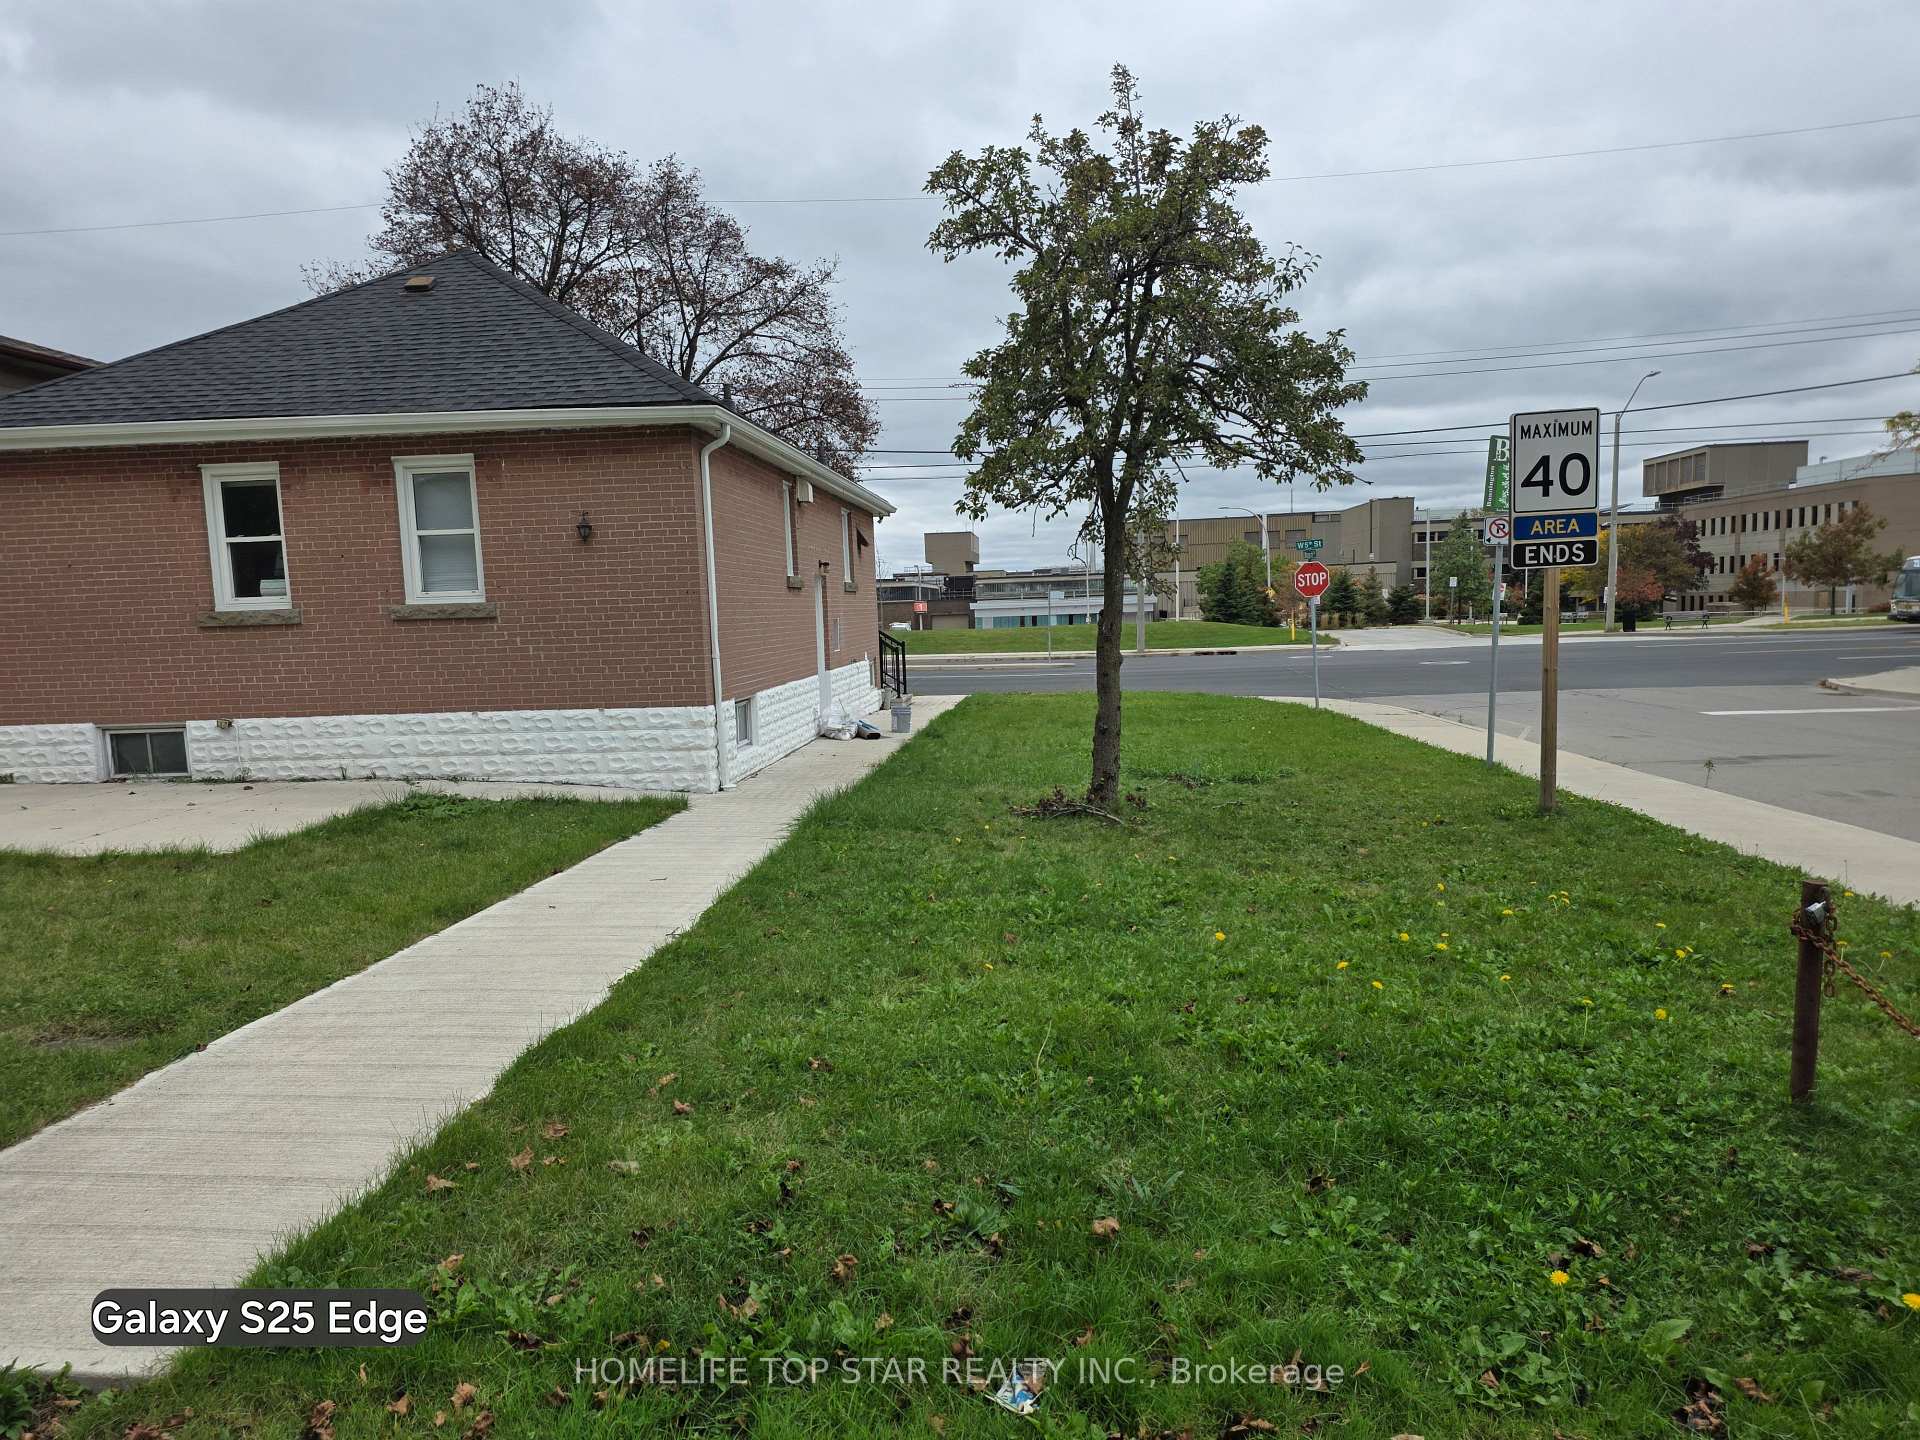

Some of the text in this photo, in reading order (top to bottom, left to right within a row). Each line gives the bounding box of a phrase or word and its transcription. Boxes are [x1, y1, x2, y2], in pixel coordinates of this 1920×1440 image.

[1520, 420, 1593, 440] MAXIMUM
[1520, 452, 1591, 498] 40
[1530, 518, 1580, 536] AREA
[1525, 543, 1585, 565] ENDS
[1297, 572, 1327, 587] STOP
